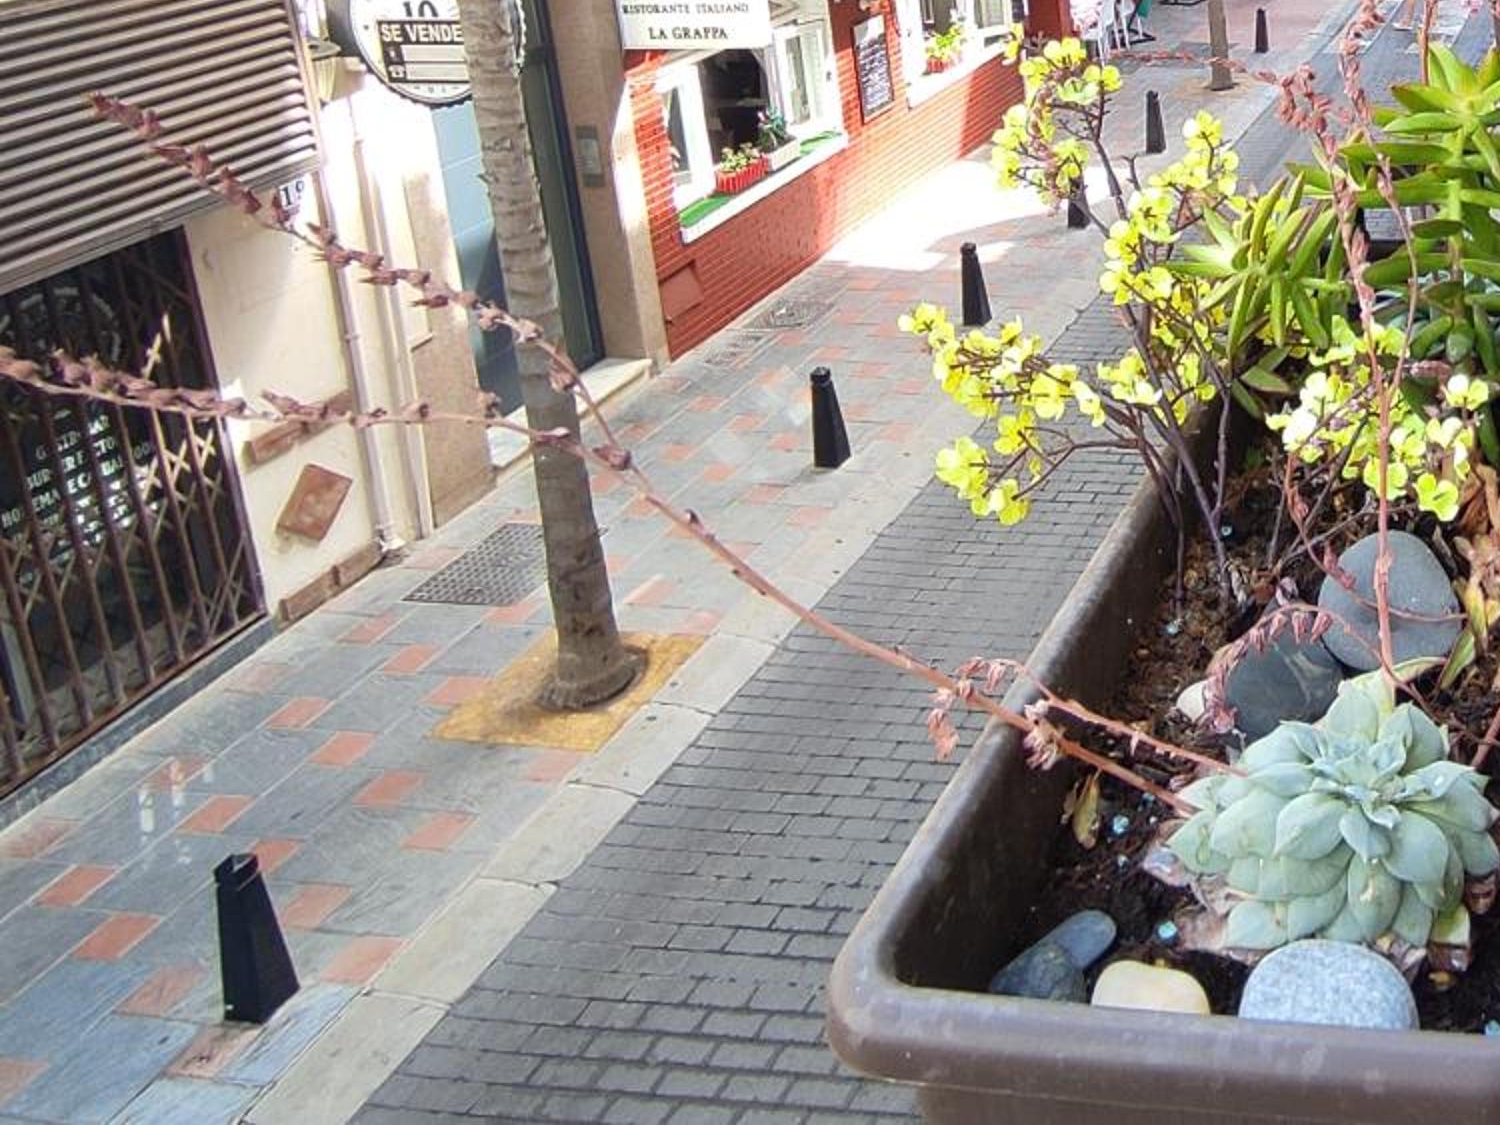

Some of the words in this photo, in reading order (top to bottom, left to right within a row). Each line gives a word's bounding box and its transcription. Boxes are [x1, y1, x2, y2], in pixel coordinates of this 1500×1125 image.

[623, 4, 690, 14] RISTORANTE
[696, 3, 749, 14] ITALIANO
[381, 25, 402, 42] SE
[405, 25, 464, 42] VENDE
[649, 27, 668, 40] LA
[673, 27, 728, 40] GRAPPA
